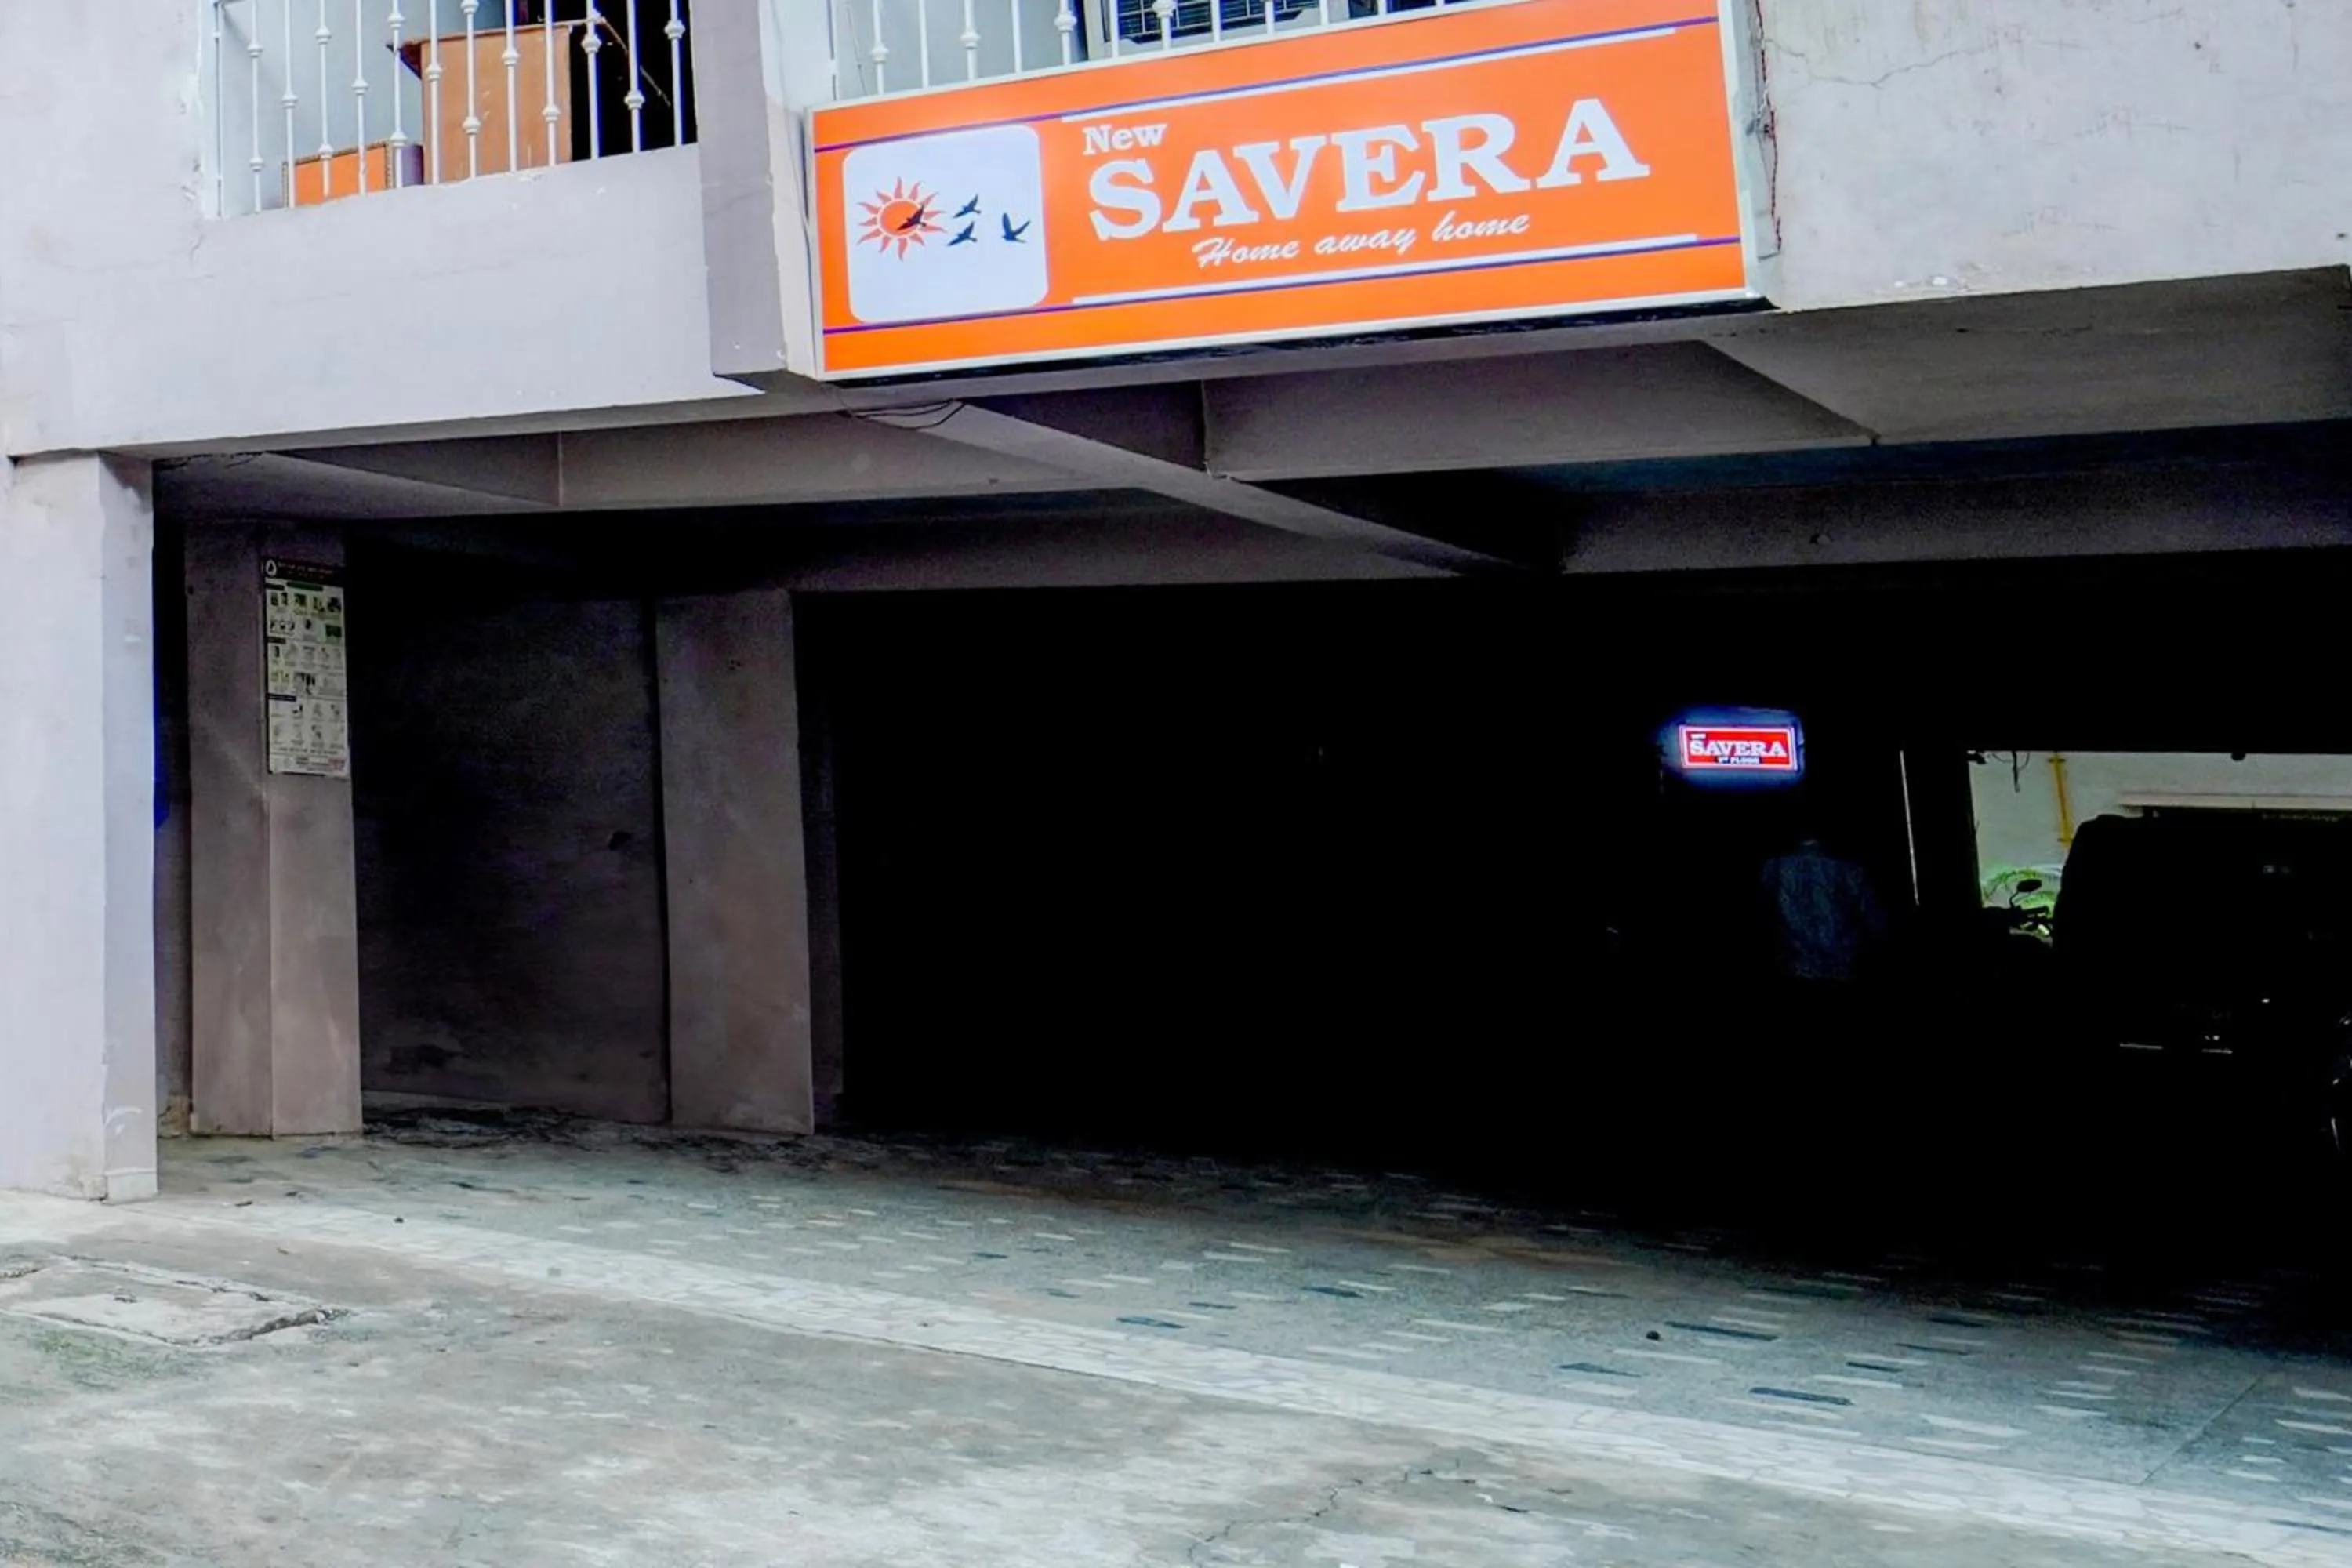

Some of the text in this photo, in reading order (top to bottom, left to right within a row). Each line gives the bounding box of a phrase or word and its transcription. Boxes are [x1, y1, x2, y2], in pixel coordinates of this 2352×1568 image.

[1082, 122, 1168, 157] New
[1088, 97, 1651, 241] SAVERA
[1192, 209, 1530, 269] Home away home
[1690, 740, 1787, 757] SAVERA
